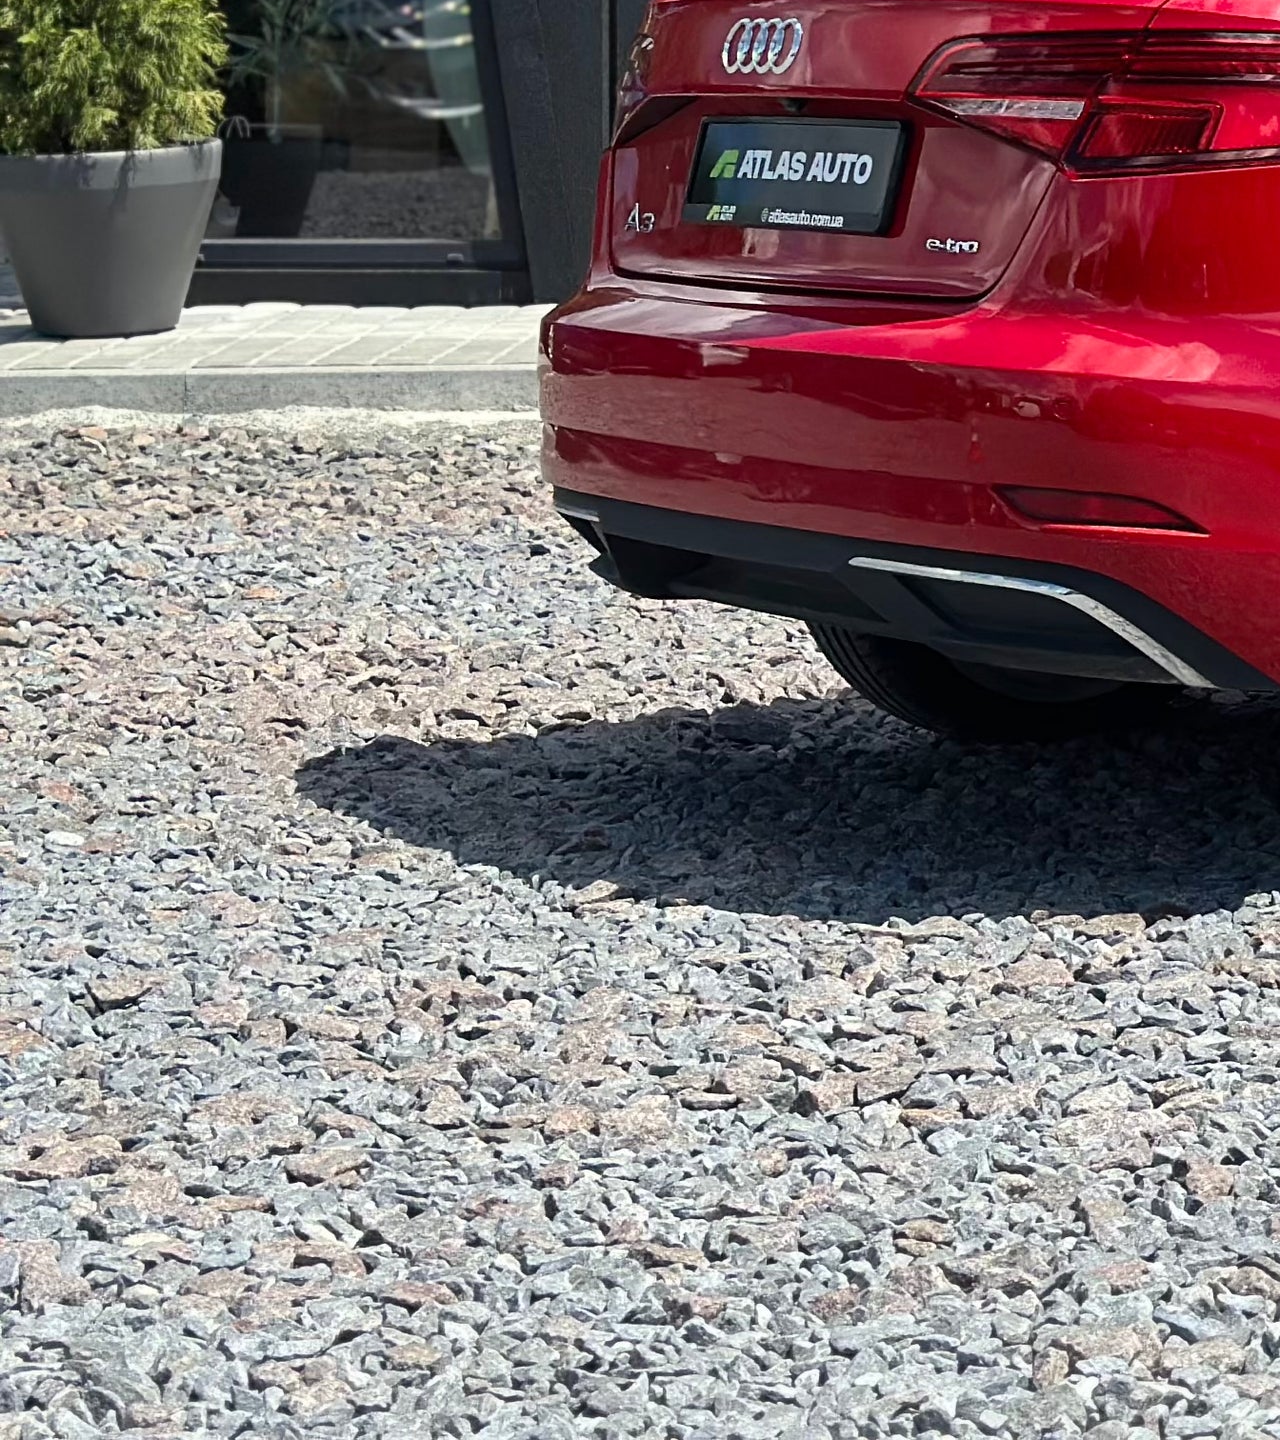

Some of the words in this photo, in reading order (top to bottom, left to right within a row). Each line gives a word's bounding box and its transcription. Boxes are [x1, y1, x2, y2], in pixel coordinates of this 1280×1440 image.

[736, 148, 807, 182] ATLAS
[806, 150, 874, 186] AUTO
[624, 202, 656, 233] A3
